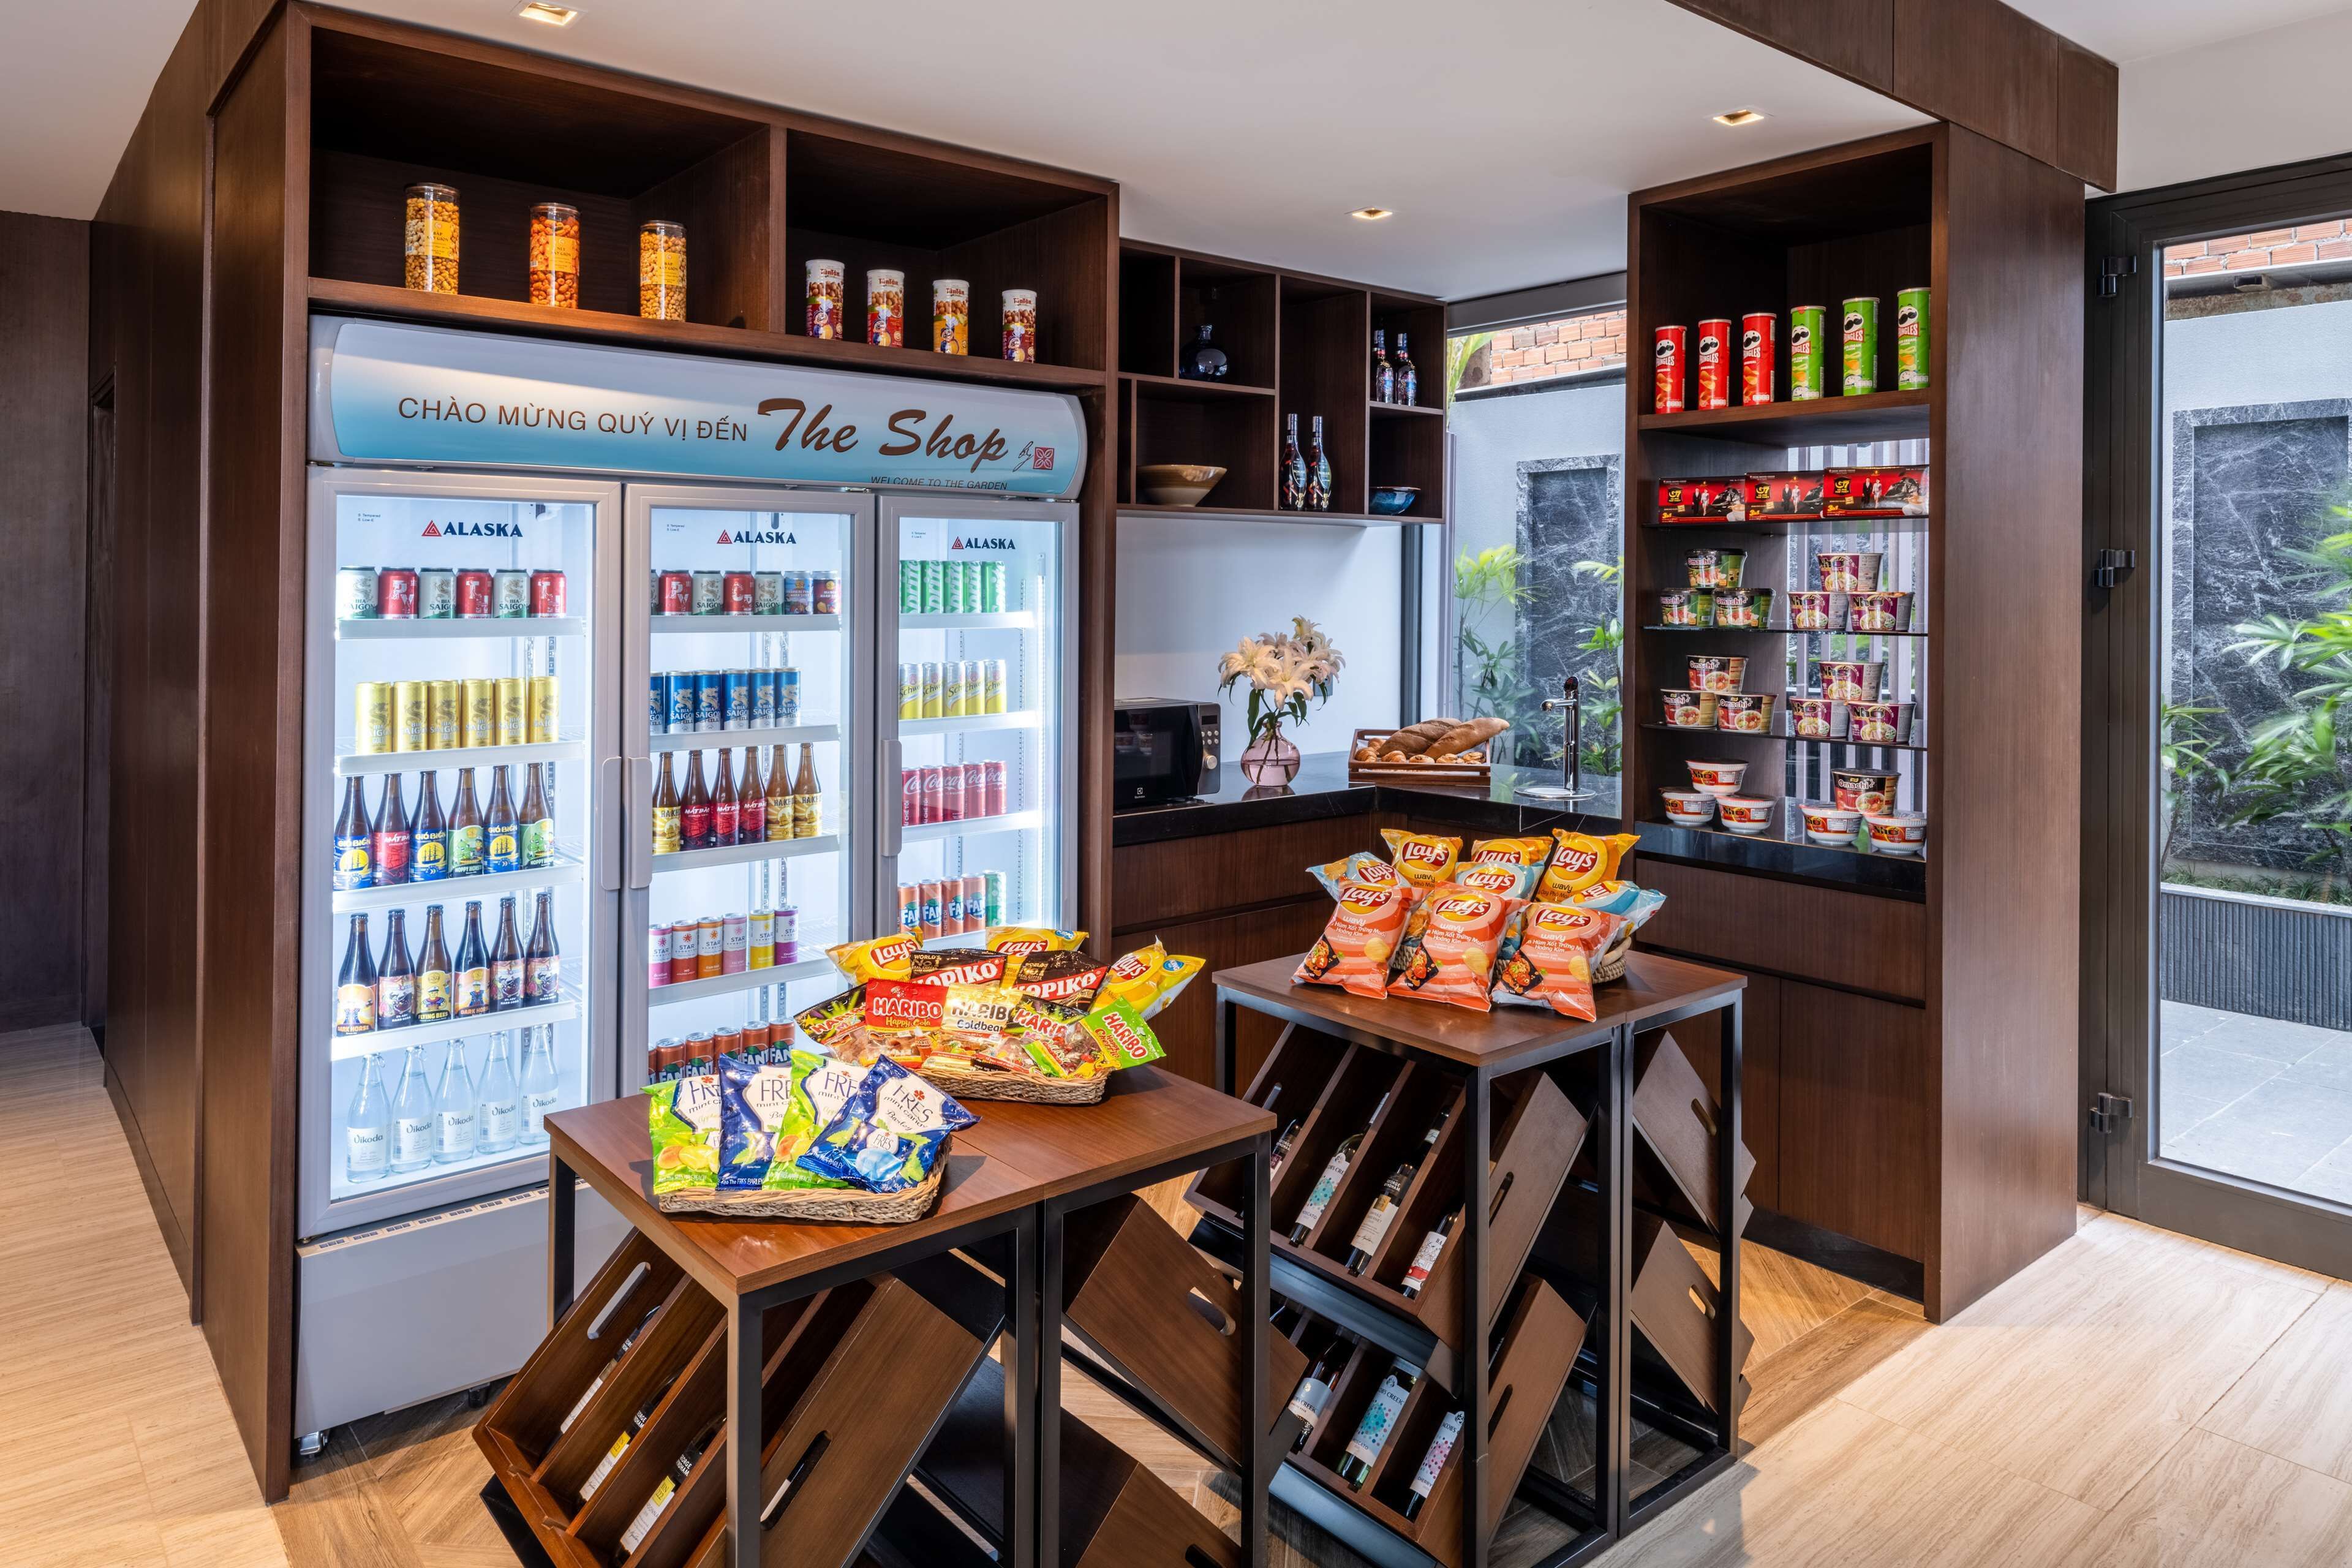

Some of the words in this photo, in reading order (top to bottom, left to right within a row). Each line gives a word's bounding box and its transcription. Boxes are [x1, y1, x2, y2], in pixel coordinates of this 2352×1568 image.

[398, 396, 486, 423] CHÀO
[498, 402, 586, 431] MỪNG
[598, 411, 654, 435] QUÝ
[664, 417, 686, 440] VỊ
[696, 415, 748, 442] ĐẾN
[758, 398, 858, 453] The
[878, 409, 1008, 473] Shop
[1012, 440, 1034, 473] by
[928, 478, 941, 487] TO
[945, 480, 963, 488] THE
[967, 481, 1008, 491] GARDEN
[443, 521, 523, 537] ALASKA
[734, 530, 796, 545] ALASKA
[965, 537, 1016, 550] ALASKA
[1838, 778, 1869, 790] Omachi
[1403, 842, 1447, 866] Lay's
[1551, 845, 1593, 872] Lay's
[1363, 862, 1396, 883] Lay's
[1414, 873, 1436, 883] wavy
[1464, 873, 1512, 889] Lay's
[1552, 881, 1574, 894] wavy
[1342, 887, 1388, 907] Lay's
[1438, 899, 1490, 919] Lay's
[1343, 916, 1367, 927] wavy
[1536, 910, 1591, 927] Lay's
[1440, 923, 1465, 932] wavy
[1541, 933, 1566, 942] wavy
[871, 938, 919, 963] Lay's
[997, 940, 1048, 957] Lay's
[873, 997, 943, 1019] HARIBO
[886, 1016, 911, 1028] Happy
[1102, 1011, 1148, 1059] HARIBO
[533, 1096, 557, 1109] Vikoda
[818, 1091, 838, 1100] mint
[689, 1100, 710, 1114] mint
[884, 1096, 903, 1110] mint
[892, 1085, 933, 1123] FRES
[492, 1104, 516, 1117] Vikoda
[448, 1114, 474, 1126] Vikoda
[886, 1109, 913, 1131] Barley
[406, 1121, 432, 1134] Vikoda
[354, 1134, 383, 1144] Vikoda
[873, 1134, 893, 1150] FRES
[1386, 1392, 1404, 1405] CREEK
